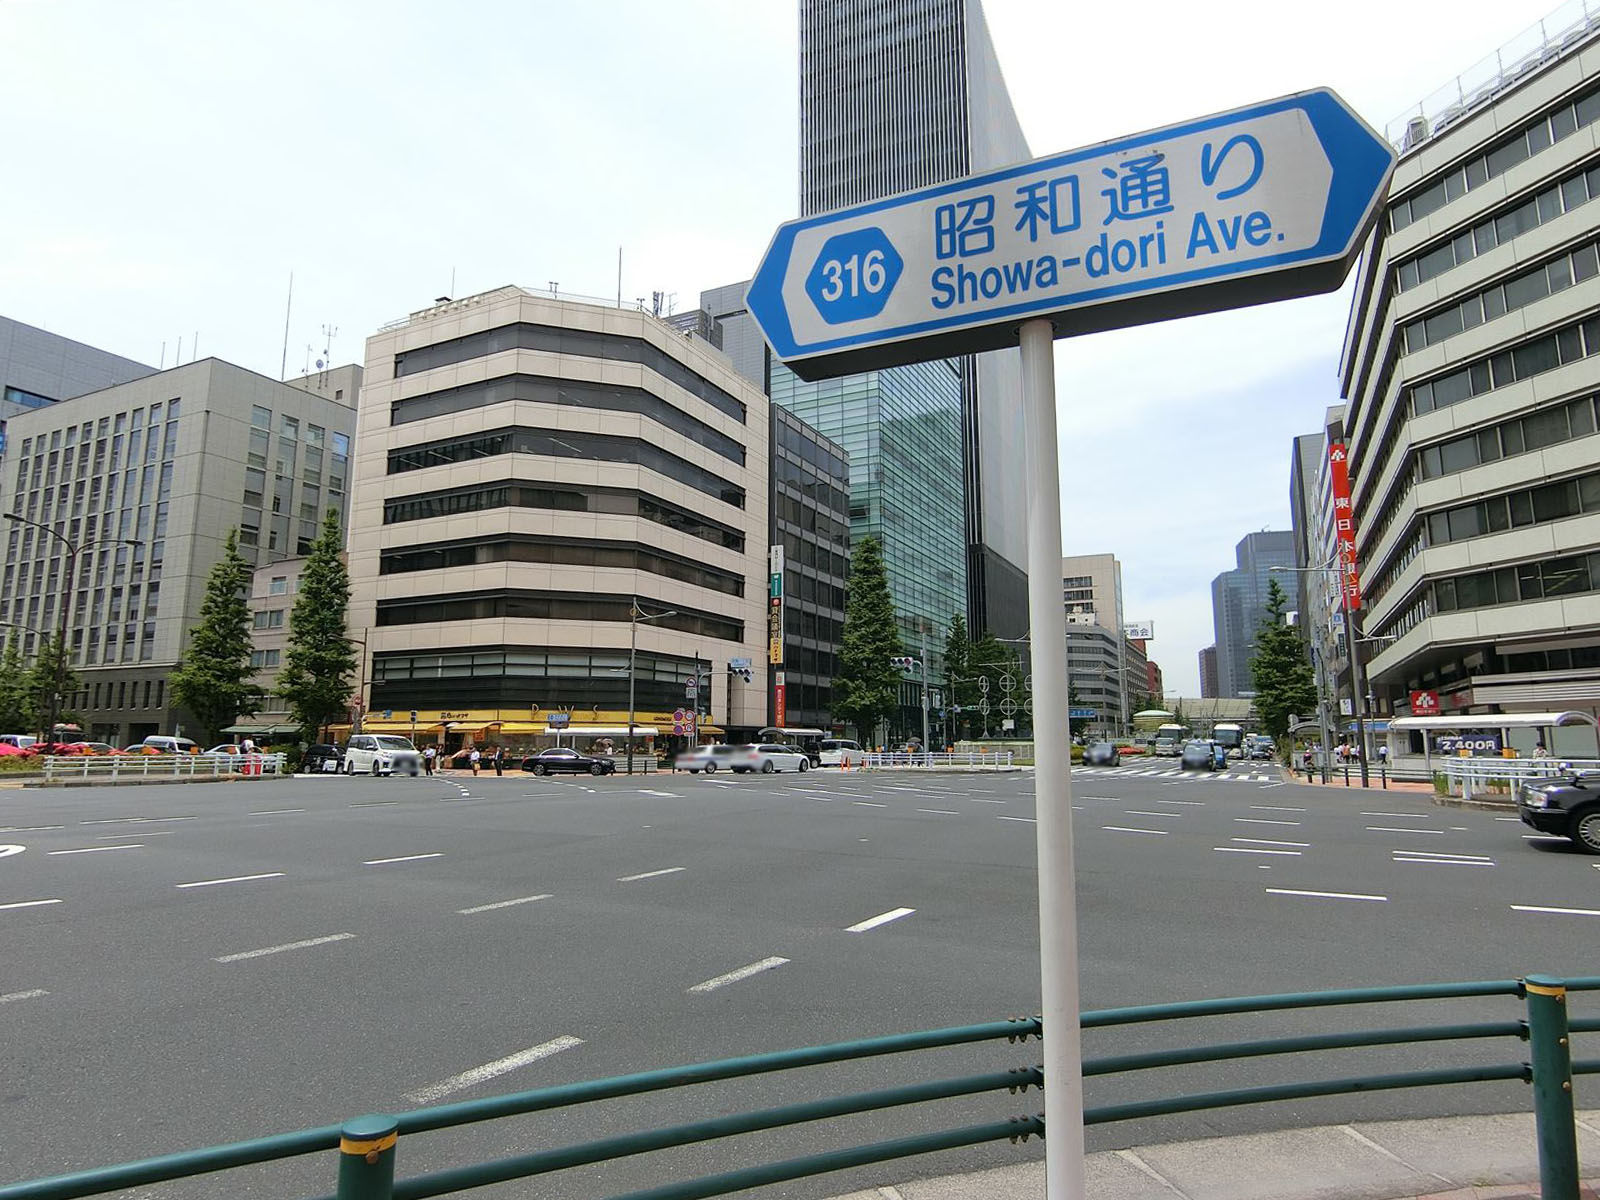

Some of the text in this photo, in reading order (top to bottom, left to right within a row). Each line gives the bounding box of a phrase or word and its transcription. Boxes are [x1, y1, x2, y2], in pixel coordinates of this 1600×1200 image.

[935, 133, 1265, 261] 昭和通り
[822, 250, 886, 302] 316
[930, 210, 1286, 310] Showa-dori Ave.
